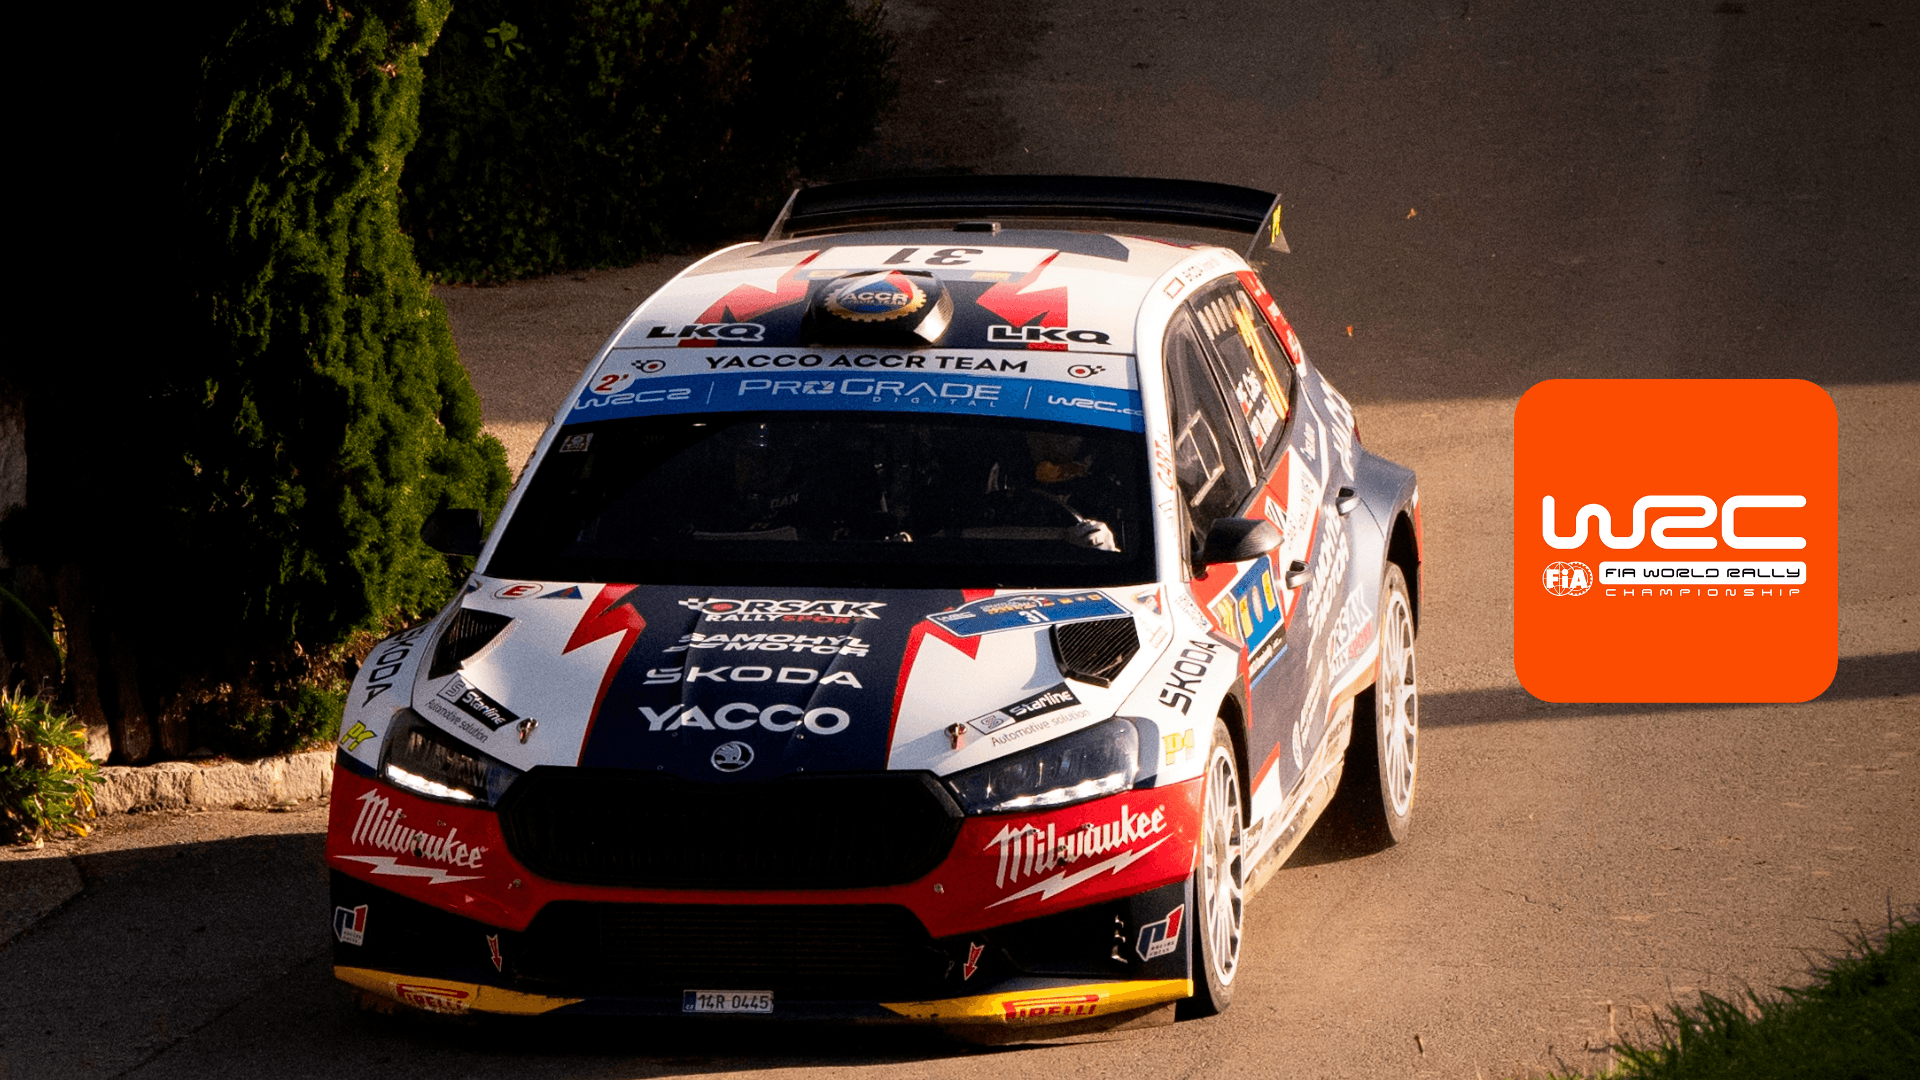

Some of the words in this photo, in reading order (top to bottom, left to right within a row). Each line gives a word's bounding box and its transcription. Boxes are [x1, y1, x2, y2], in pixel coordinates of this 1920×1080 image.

[842, 292, 909, 306] ACCR
[646, 323, 765, 341] LKQ
[987, 324, 1112, 345] LKQ
[706, 354, 822, 369] YACCO
[829, 354, 925, 369] ACCR
[935, 356, 1028, 373] TEAM
[873, 396, 997, 408] DIGITAL
[702, 598, 887, 620] ORSAK
[1019, 609, 1050, 623] 31
[678, 632, 871, 648] SAMOHYL
[722, 642, 870, 657] MOTOR
[461, 691, 507, 725] Starline
[1009, 687, 1074, 717] Starline
[637, 702, 851, 735] YACCO
[990, 719, 1051, 747] Automotive
[1050, 707, 1091, 729] solution
[458, 720, 489, 743] solution
[352, 788, 484, 869] Milwaukee
[983, 804, 1168, 889] Milwaukee
[731, 994, 770, 1010] 0445
[1001, 993, 1100, 1021] PIRELLI
